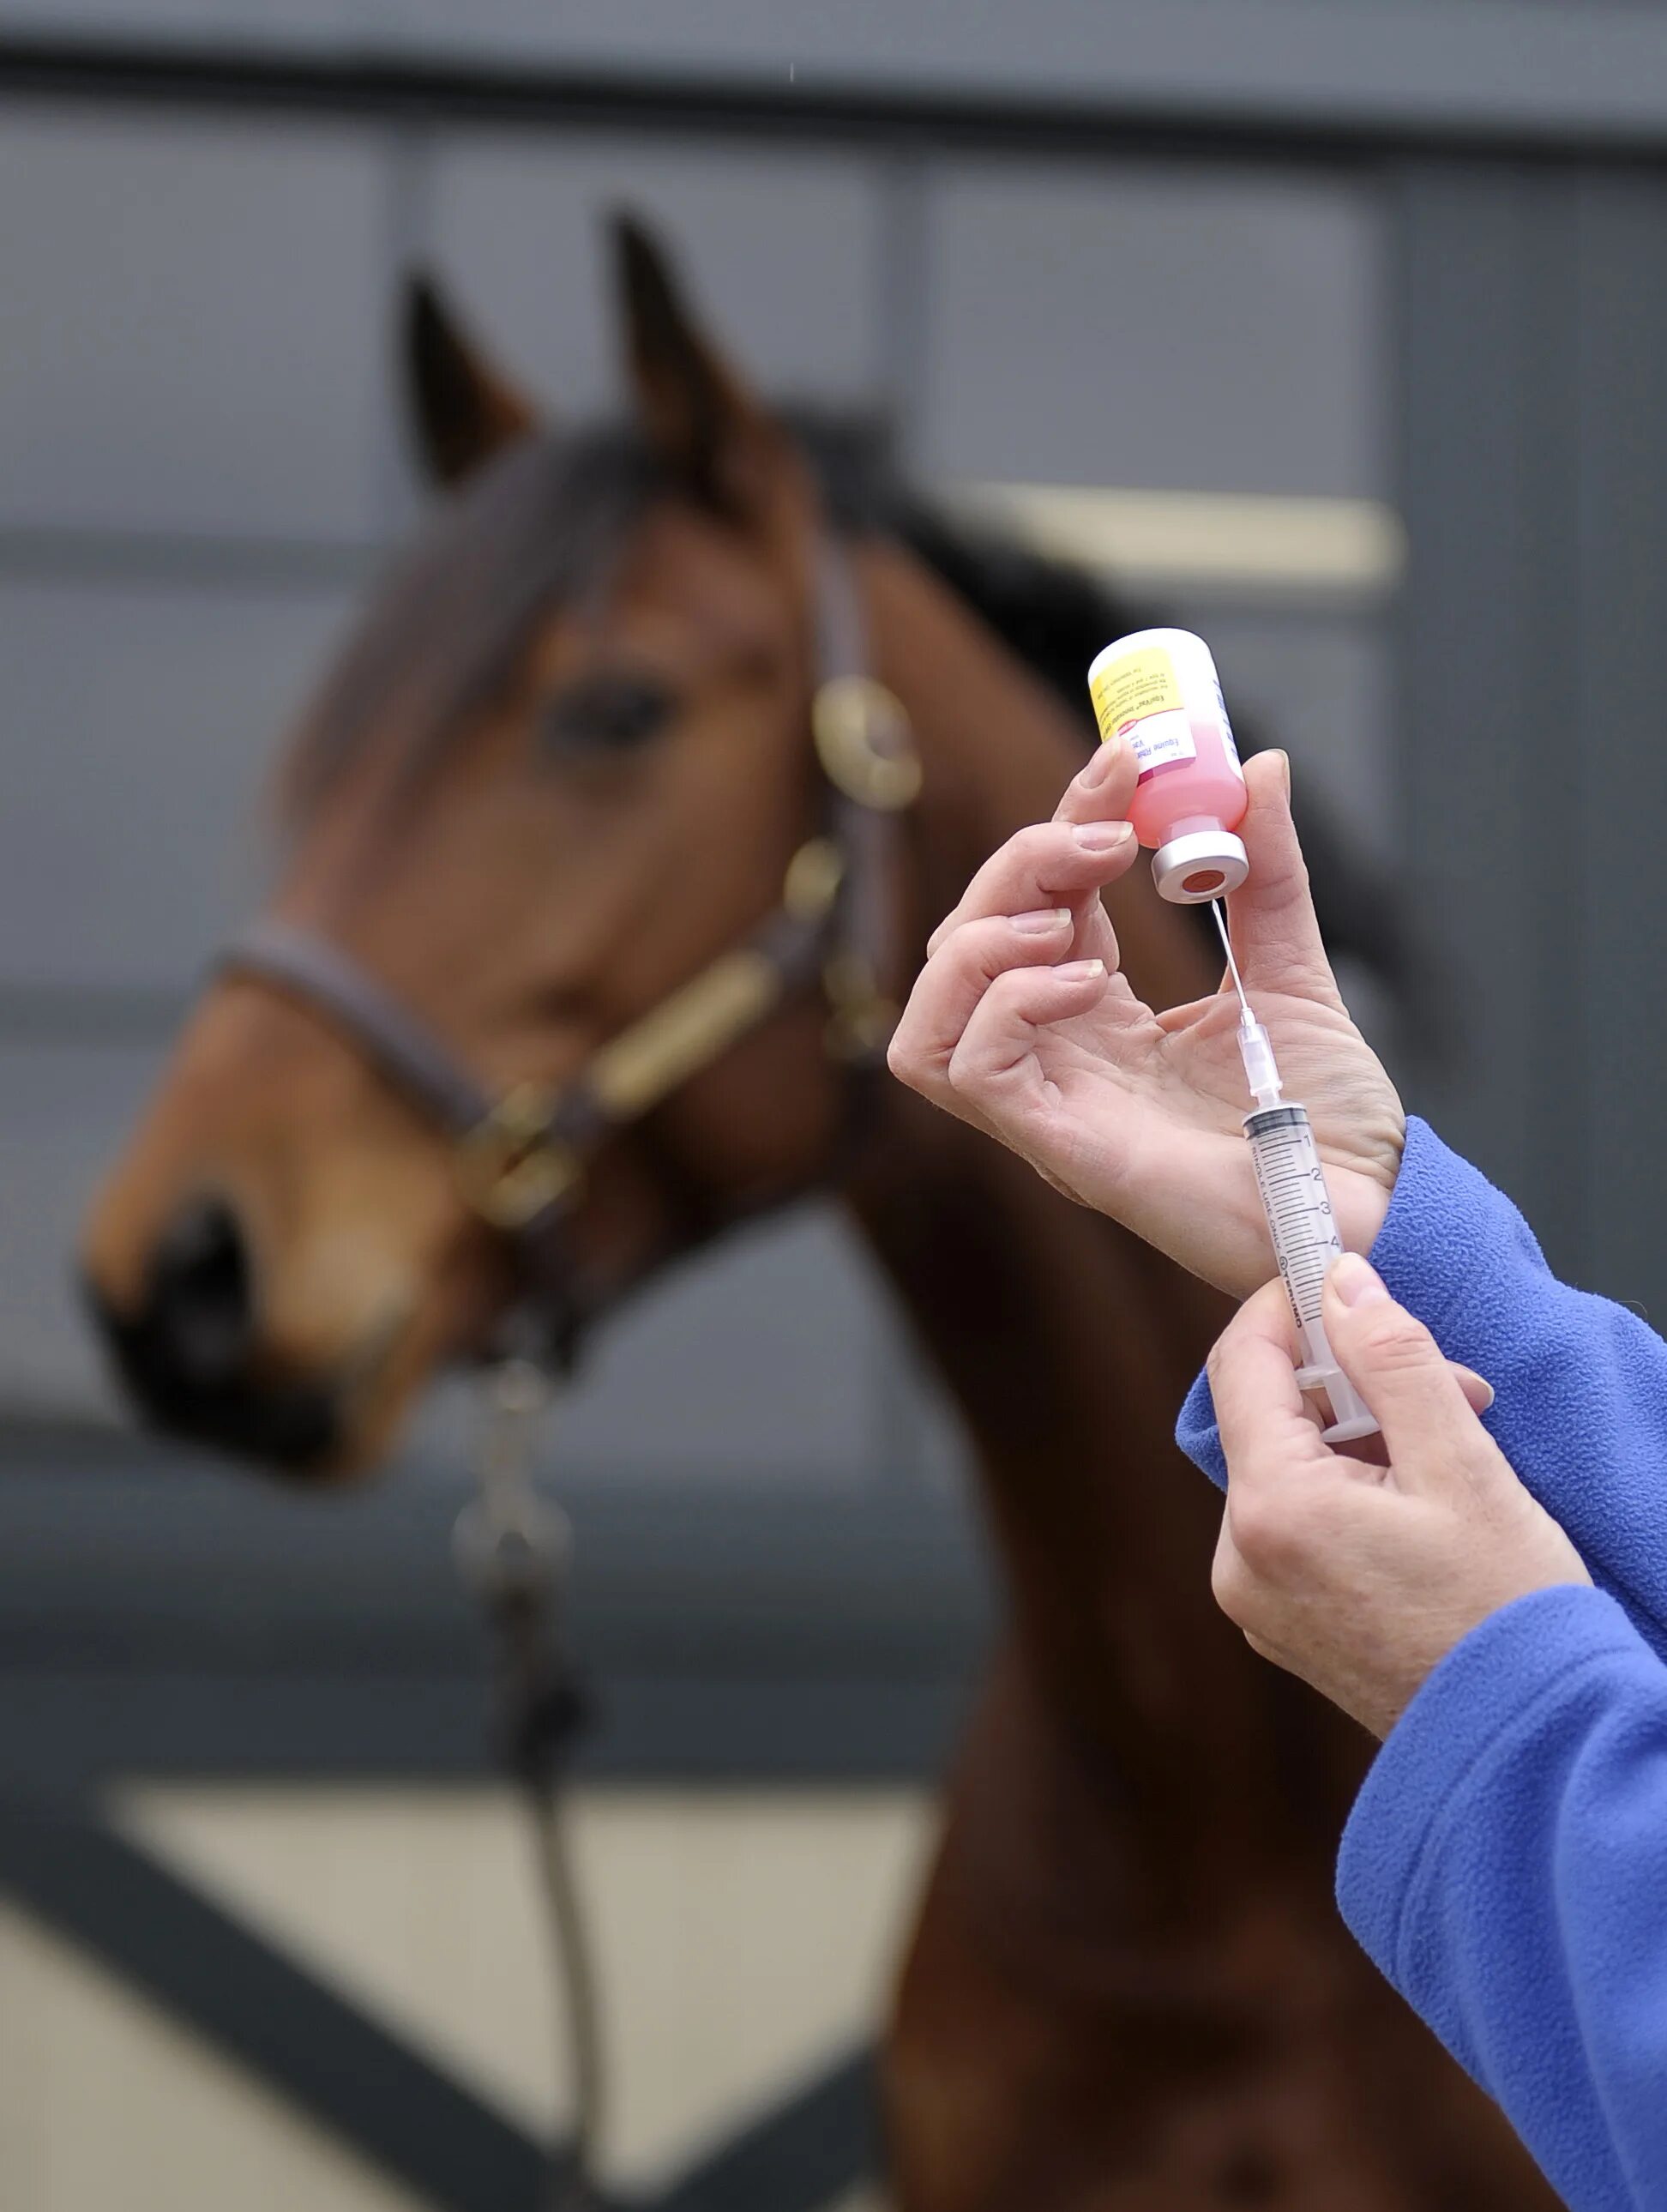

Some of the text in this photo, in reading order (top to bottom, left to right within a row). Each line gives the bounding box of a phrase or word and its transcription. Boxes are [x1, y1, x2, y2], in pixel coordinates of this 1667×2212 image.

[1303, 1135, 1311, 1148] 1
[1311, 1167, 1323, 1181] 2
[1251, 1147, 1281, 1249] SINGLE USE ONLY
[1320, 1201, 1332, 1215] 3
[1331, 1235, 1339, 1247] 4
[1283, 1270, 1303, 1329] TERUMO
